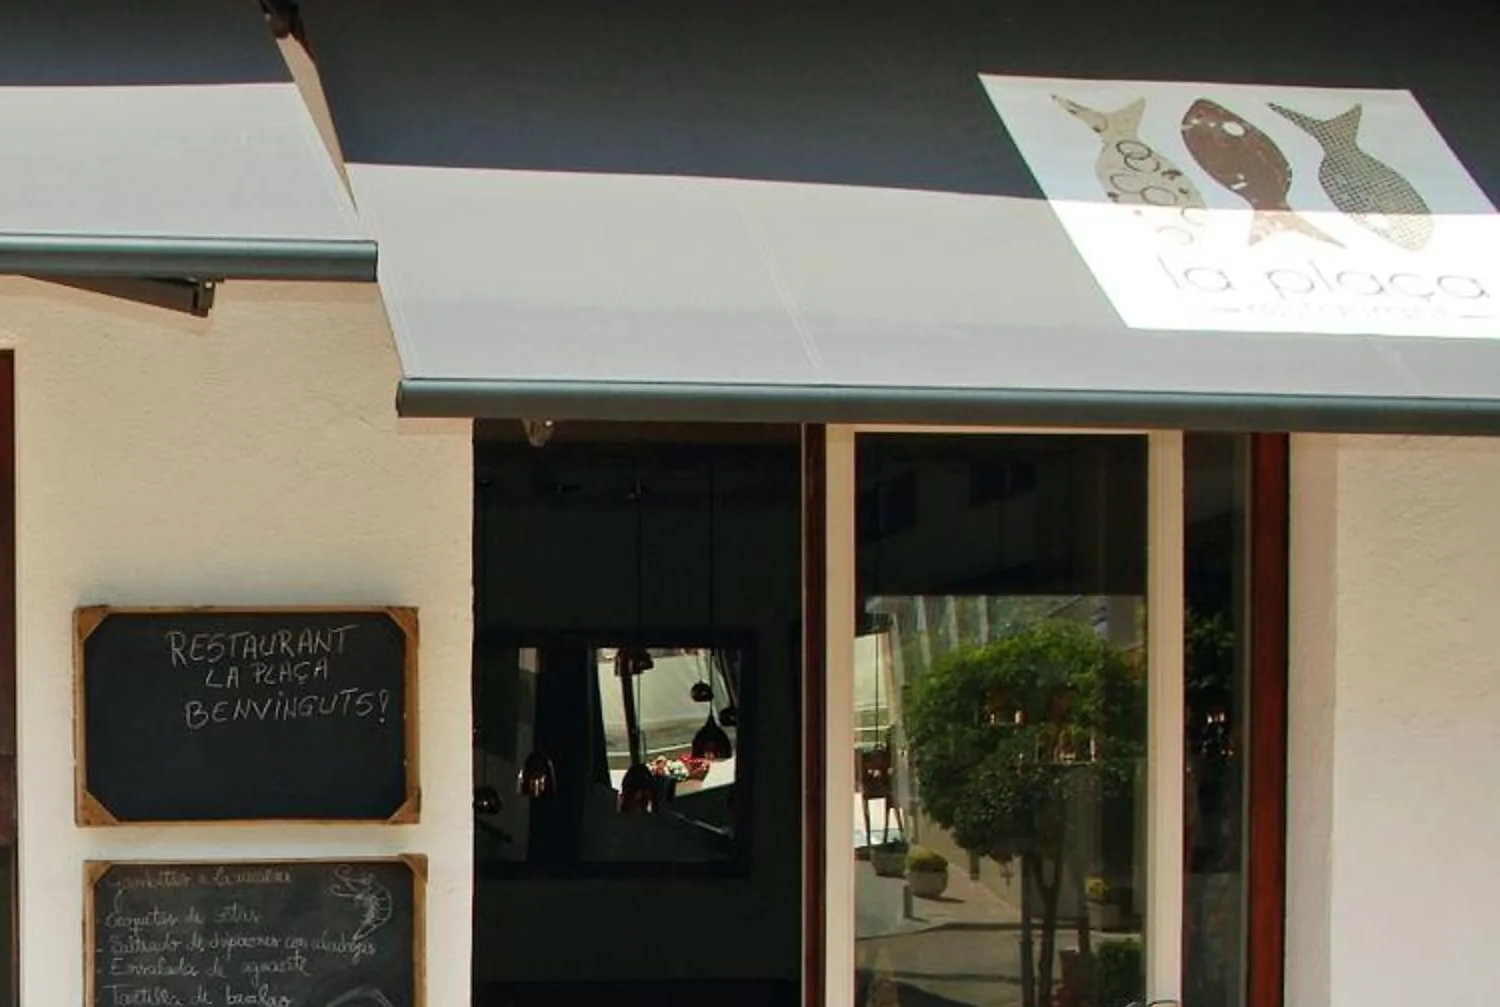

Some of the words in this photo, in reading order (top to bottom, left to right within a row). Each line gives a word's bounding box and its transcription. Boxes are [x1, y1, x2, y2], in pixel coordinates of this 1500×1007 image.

[1156, 253, 1237, 293] la
[165, 624, 357, 667] RESTAURANT
[205, 666, 239, 689] LA
